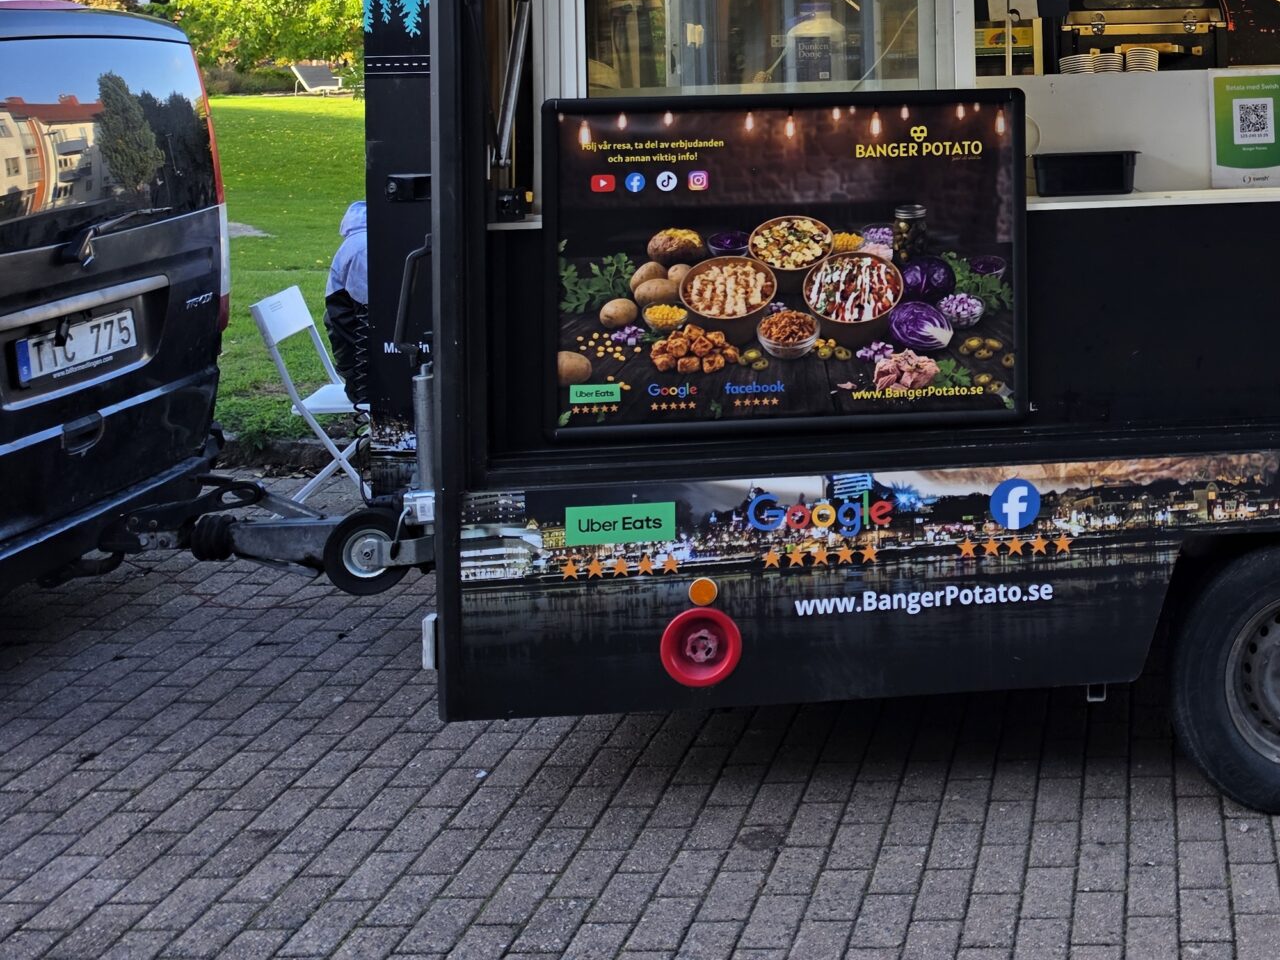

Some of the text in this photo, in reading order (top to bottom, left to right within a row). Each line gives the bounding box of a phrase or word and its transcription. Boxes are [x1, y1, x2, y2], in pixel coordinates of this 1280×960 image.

[598, 141, 611, 150] vår
[613, 142, 633, 151] resa,
[645, 140, 658, 149] del
[670, 139, 724, 149] erbjudanden
[855, 141, 983, 158] BANGER POTATO
[608, 154, 623, 163] och
[652, 153, 677, 163] viktig
[677, 152, 698, 161] info!
[90, 316, 130, 354] 775
[23, 366, 28, 374] S
[575, 390, 594, 398] Uber
[647, 382, 697, 399] Google
[724, 381, 785, 394] facebook
[852, 385, 984, 400] www.BangerPotato.se
[748, 490, 893, 537] Google
[578, 516, 662, 533] Uber Eats
[794, 583, 1054, 616] www.BangerPotato.se
